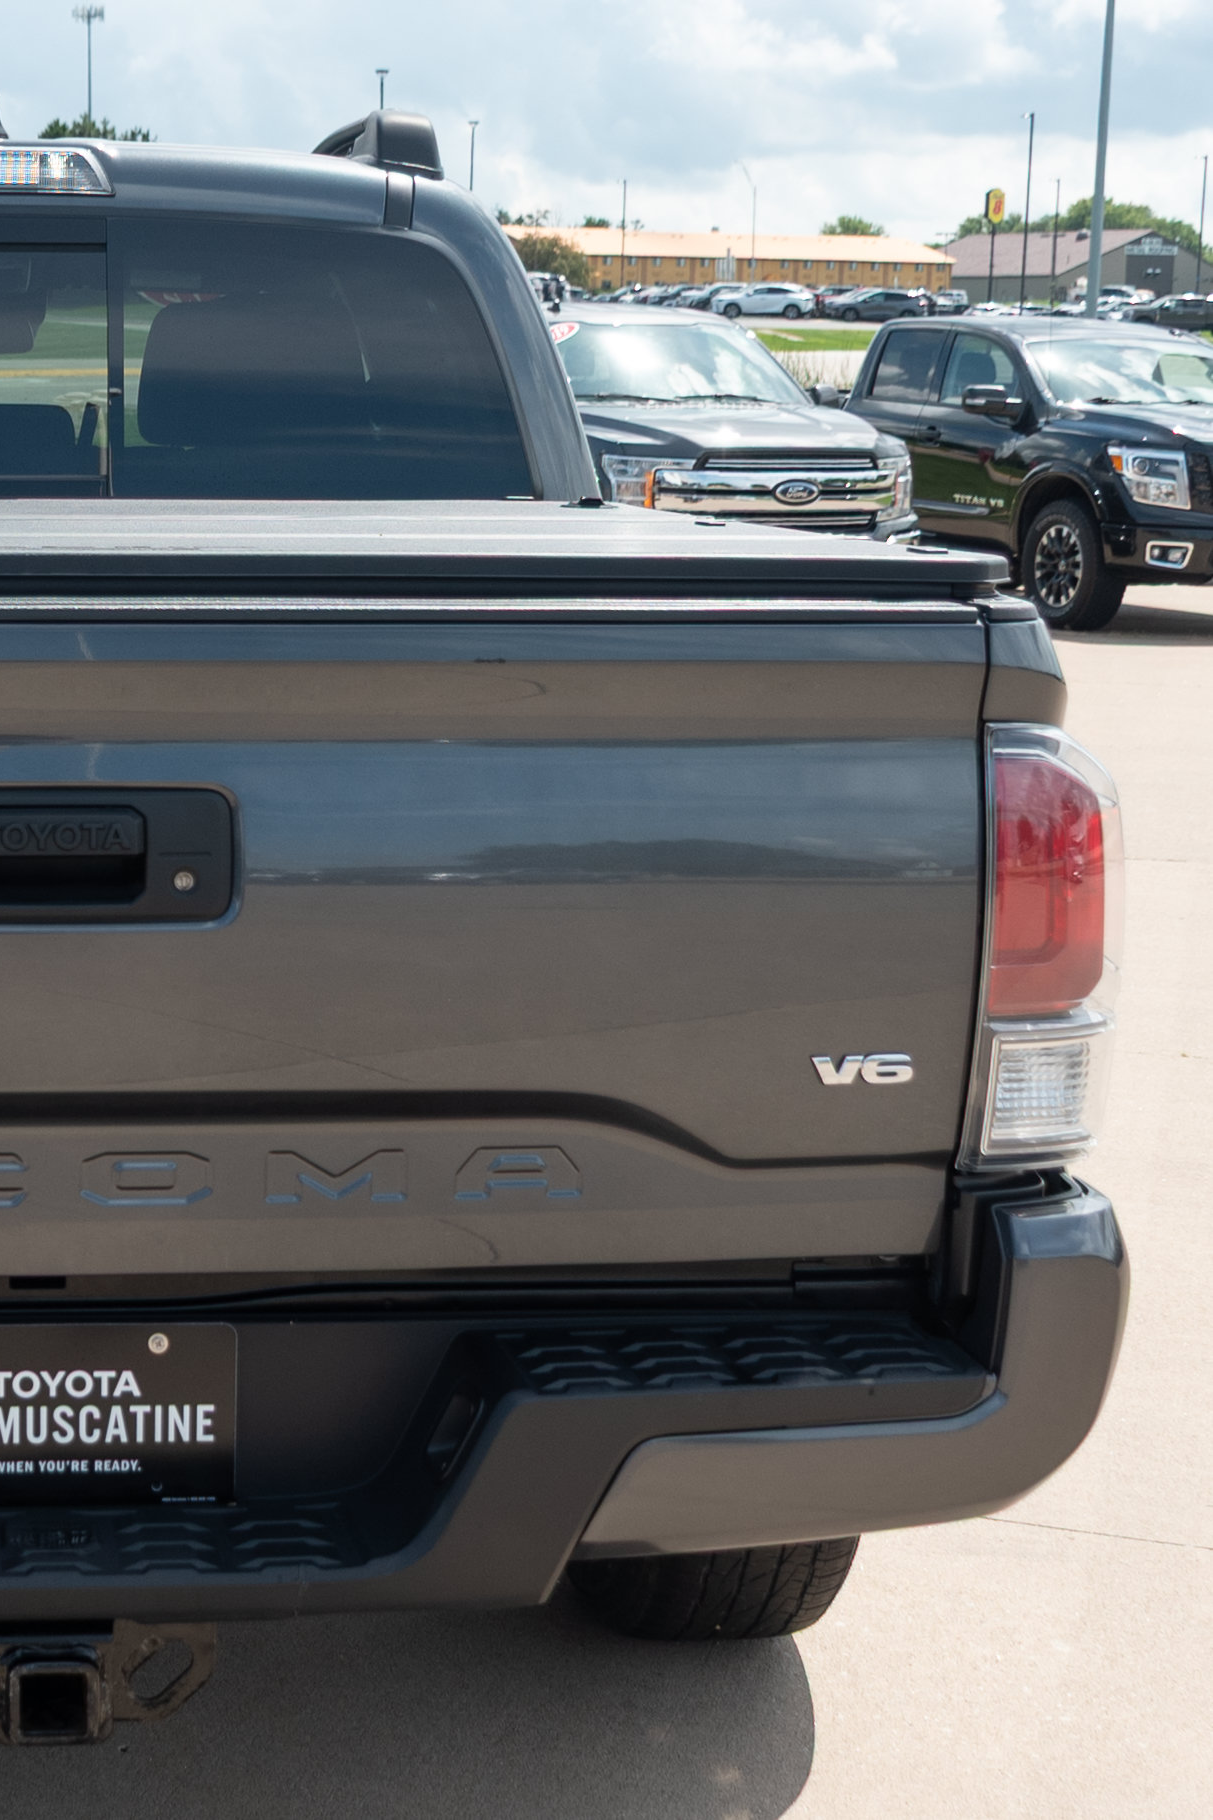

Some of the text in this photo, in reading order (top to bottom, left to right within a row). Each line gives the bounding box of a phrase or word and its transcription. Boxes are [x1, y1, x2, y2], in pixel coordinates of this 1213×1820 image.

[810, 1053, 914, 1085] V6
[38, 1460, 89, 1473] YOU'RE
[94, 1459, 142, 1473] READY.
